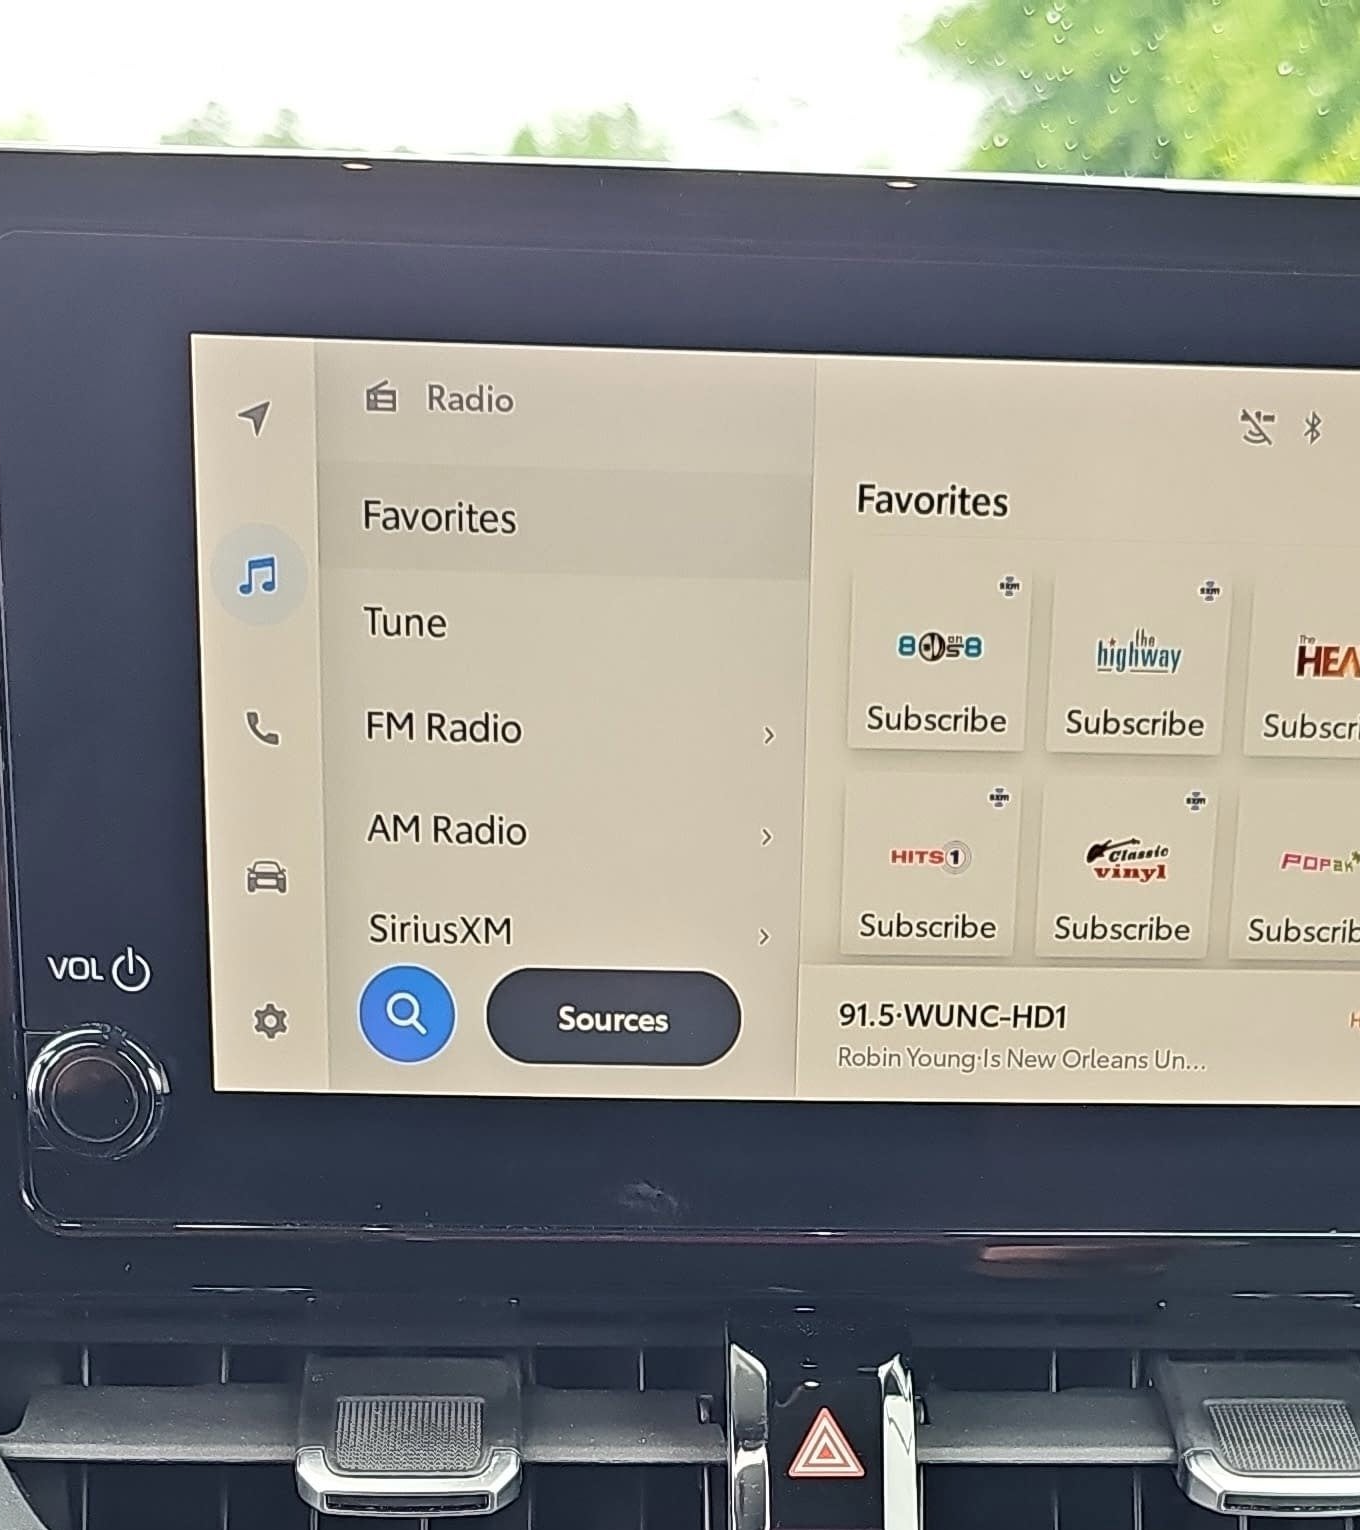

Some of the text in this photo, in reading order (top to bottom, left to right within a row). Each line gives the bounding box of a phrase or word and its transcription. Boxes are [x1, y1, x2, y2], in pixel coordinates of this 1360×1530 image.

[428, 384, 515, 415] Radio
[857, 484, 1010, 519] Favorites
[363, 500, 517, 535] Favorites
[364, 606, 448, 639] Tune
[1096, 640, 1182, 673] highway
[366, 713, 523, 745] FM Radio
[866, 704, 1008, 733] Subscribe
[1065, 709, 1206, 737] Subscribe
[367, 815, 528, 846] AM Radio
[1108, 845, 1170, 863] Classic
[1093, 864, 1168, 883] vinyl
[368, 915, 514, 945] SiriusXM
[859, 912, 997, 940] Subscribe
[1054, 915, 1191, 942] Subscribe
[46, 955, 105, 981] VOL
[558, 1006, 670, 1033] Sources
[838, 1047, 901, 1068] Robin
[1007, 1049, 1057, 1069] New
[1062, 1049, 1148, 1070] Orleans
[1154, 1050, 1207, 1070] Un...
